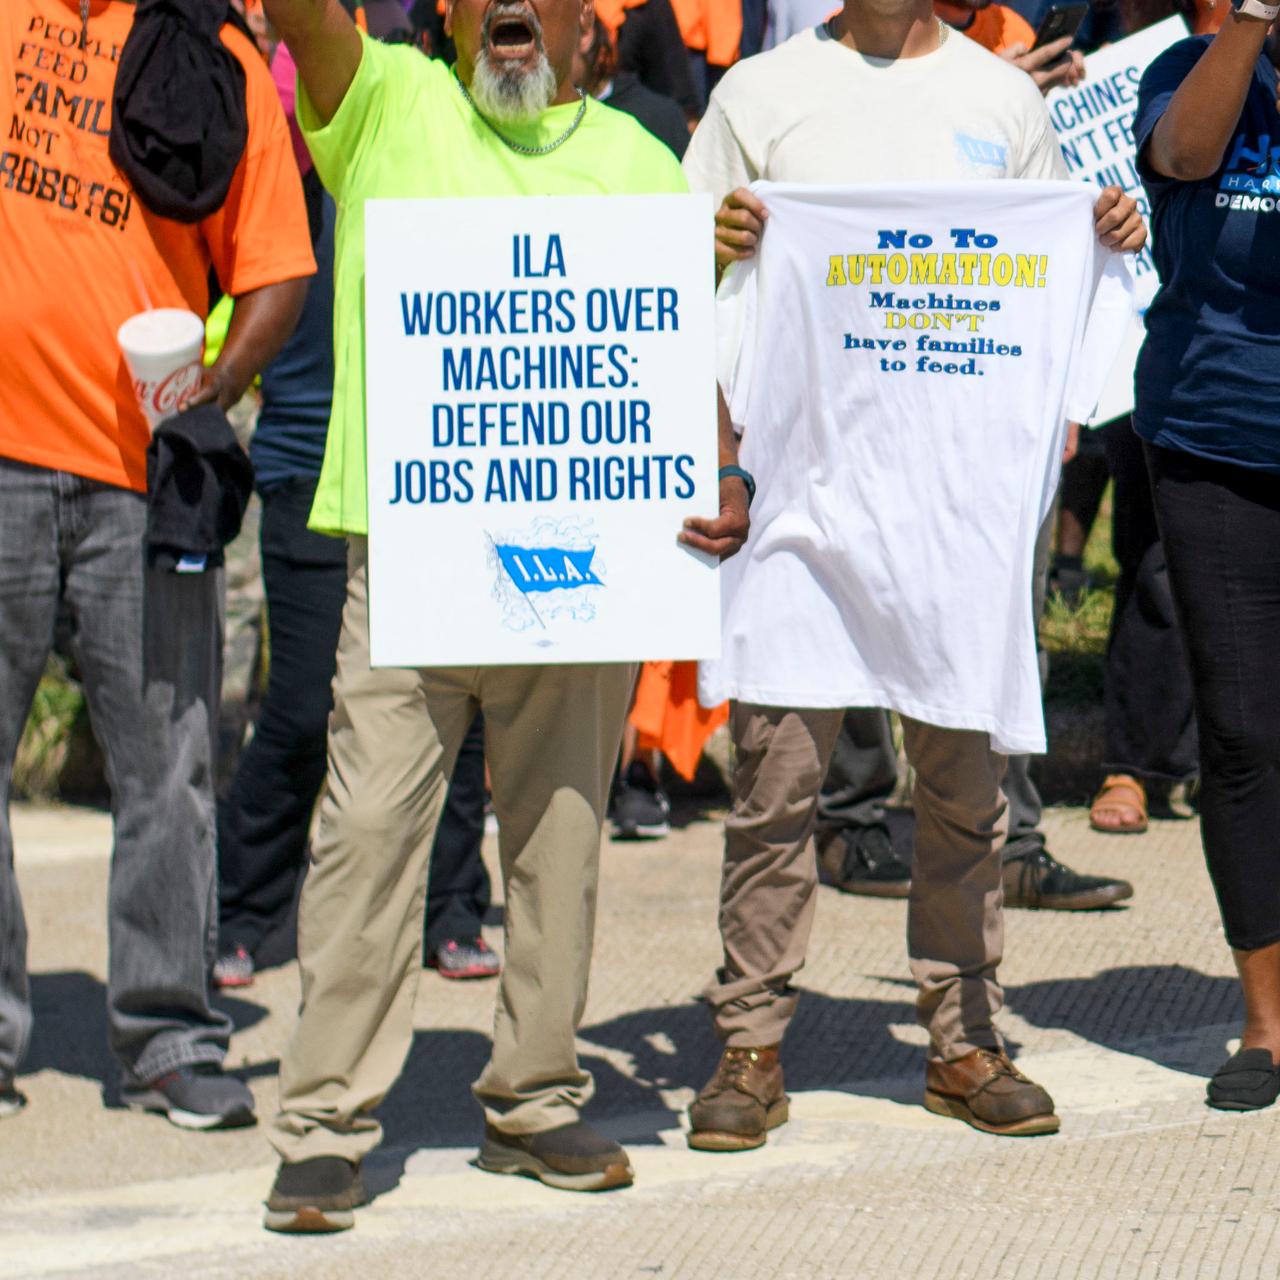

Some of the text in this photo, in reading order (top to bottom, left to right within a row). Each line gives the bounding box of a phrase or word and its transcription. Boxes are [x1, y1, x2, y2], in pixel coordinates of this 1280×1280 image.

[17, 42, 88, 84] FEED
[15, 71, 112, 137] FAMIL
[1050, 65, 1141, 135] CHINES
[8, 113, 60, 155] NOT
[1060, 110, 1137, 173] N'T FE
[0, 151, 133, 232] ROBOTS!
[512, 233, 567, 278] ILA
[877, 228, 998, 250] No To
[826, 253, 1049, 288] AUTOMATION!
[399, 287, 679, 336] WORKERS OVER
[868, 291, 1001, 312] Machines
[883, 311, 985, 332] DON'T
[843, 333, 1022, 357] have families
[880, 357, 985, 376] to feed.
[442, 344, 639, 391] MACHINES:
[432, 399, 652, 448] DEFEND OUR
[388, 454, 696, 505] JOBS AND RIGHTS
[512, 554, 590, 584] I.L.A.
